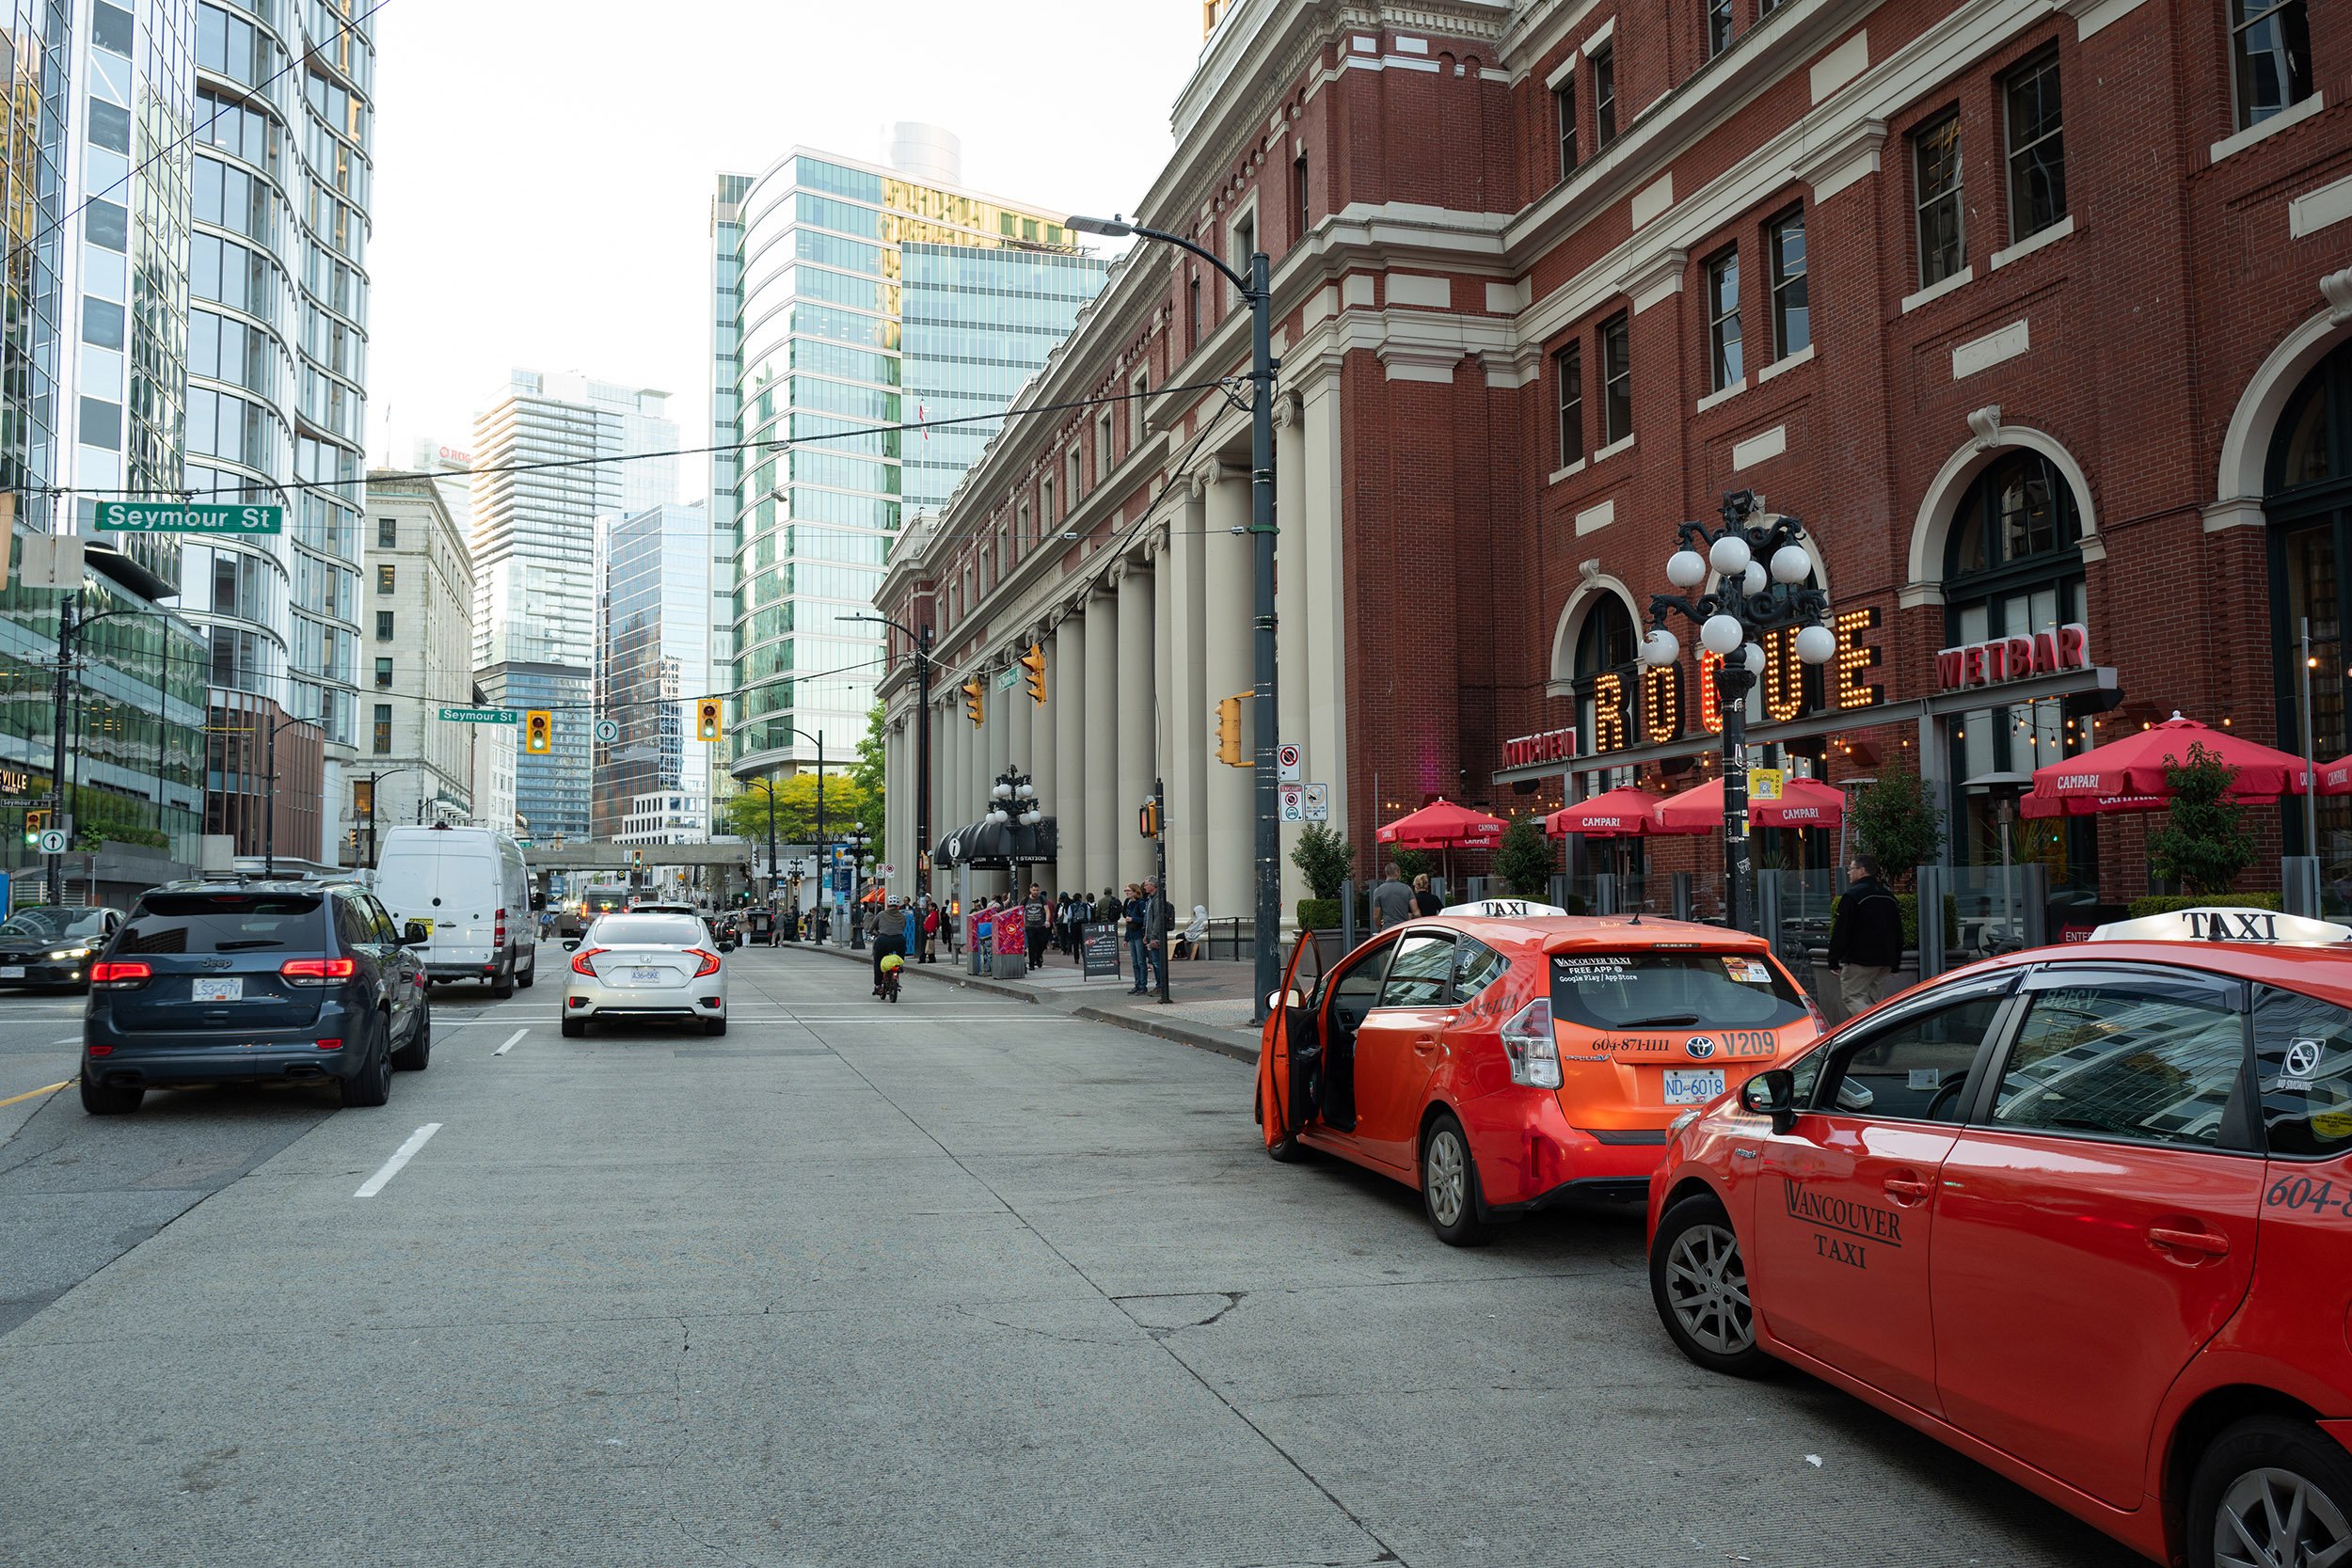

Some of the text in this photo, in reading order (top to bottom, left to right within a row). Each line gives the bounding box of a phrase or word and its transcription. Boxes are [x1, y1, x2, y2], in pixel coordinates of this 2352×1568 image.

[107, 505, 270, 529] Seymour St
[1925, 628, 2083, 690] WETBAR
[443, 709, 513, 721] Seymour St
[1502, 730, 1574, 768] KITCHEN
[0, 769, 26, 790] VILLE
[2058, 774, 2100, 789] CAMPARI
[1783, 807, 1819, 820] CAMPARI
[1478, 824, 1499, 832] CAMPARI
[1582, 817, 1620, 827] CAMPARI
[1482, 902, 1529, 916] TAXI
[2182, 912, 2280, 941] TAXI
[201, 957, 232, 969] Jeep
[1554, 958, 1606, 967] VANCOUVER
[1592, 1038, 1669, 1051] 604-871-1111
[2277, 1079, 2312, 1091] NO SMOKING
[1784, 1179, 1901, 1240] VANCOUVER
[1814, 1233, 1867, 1269] TAXI
